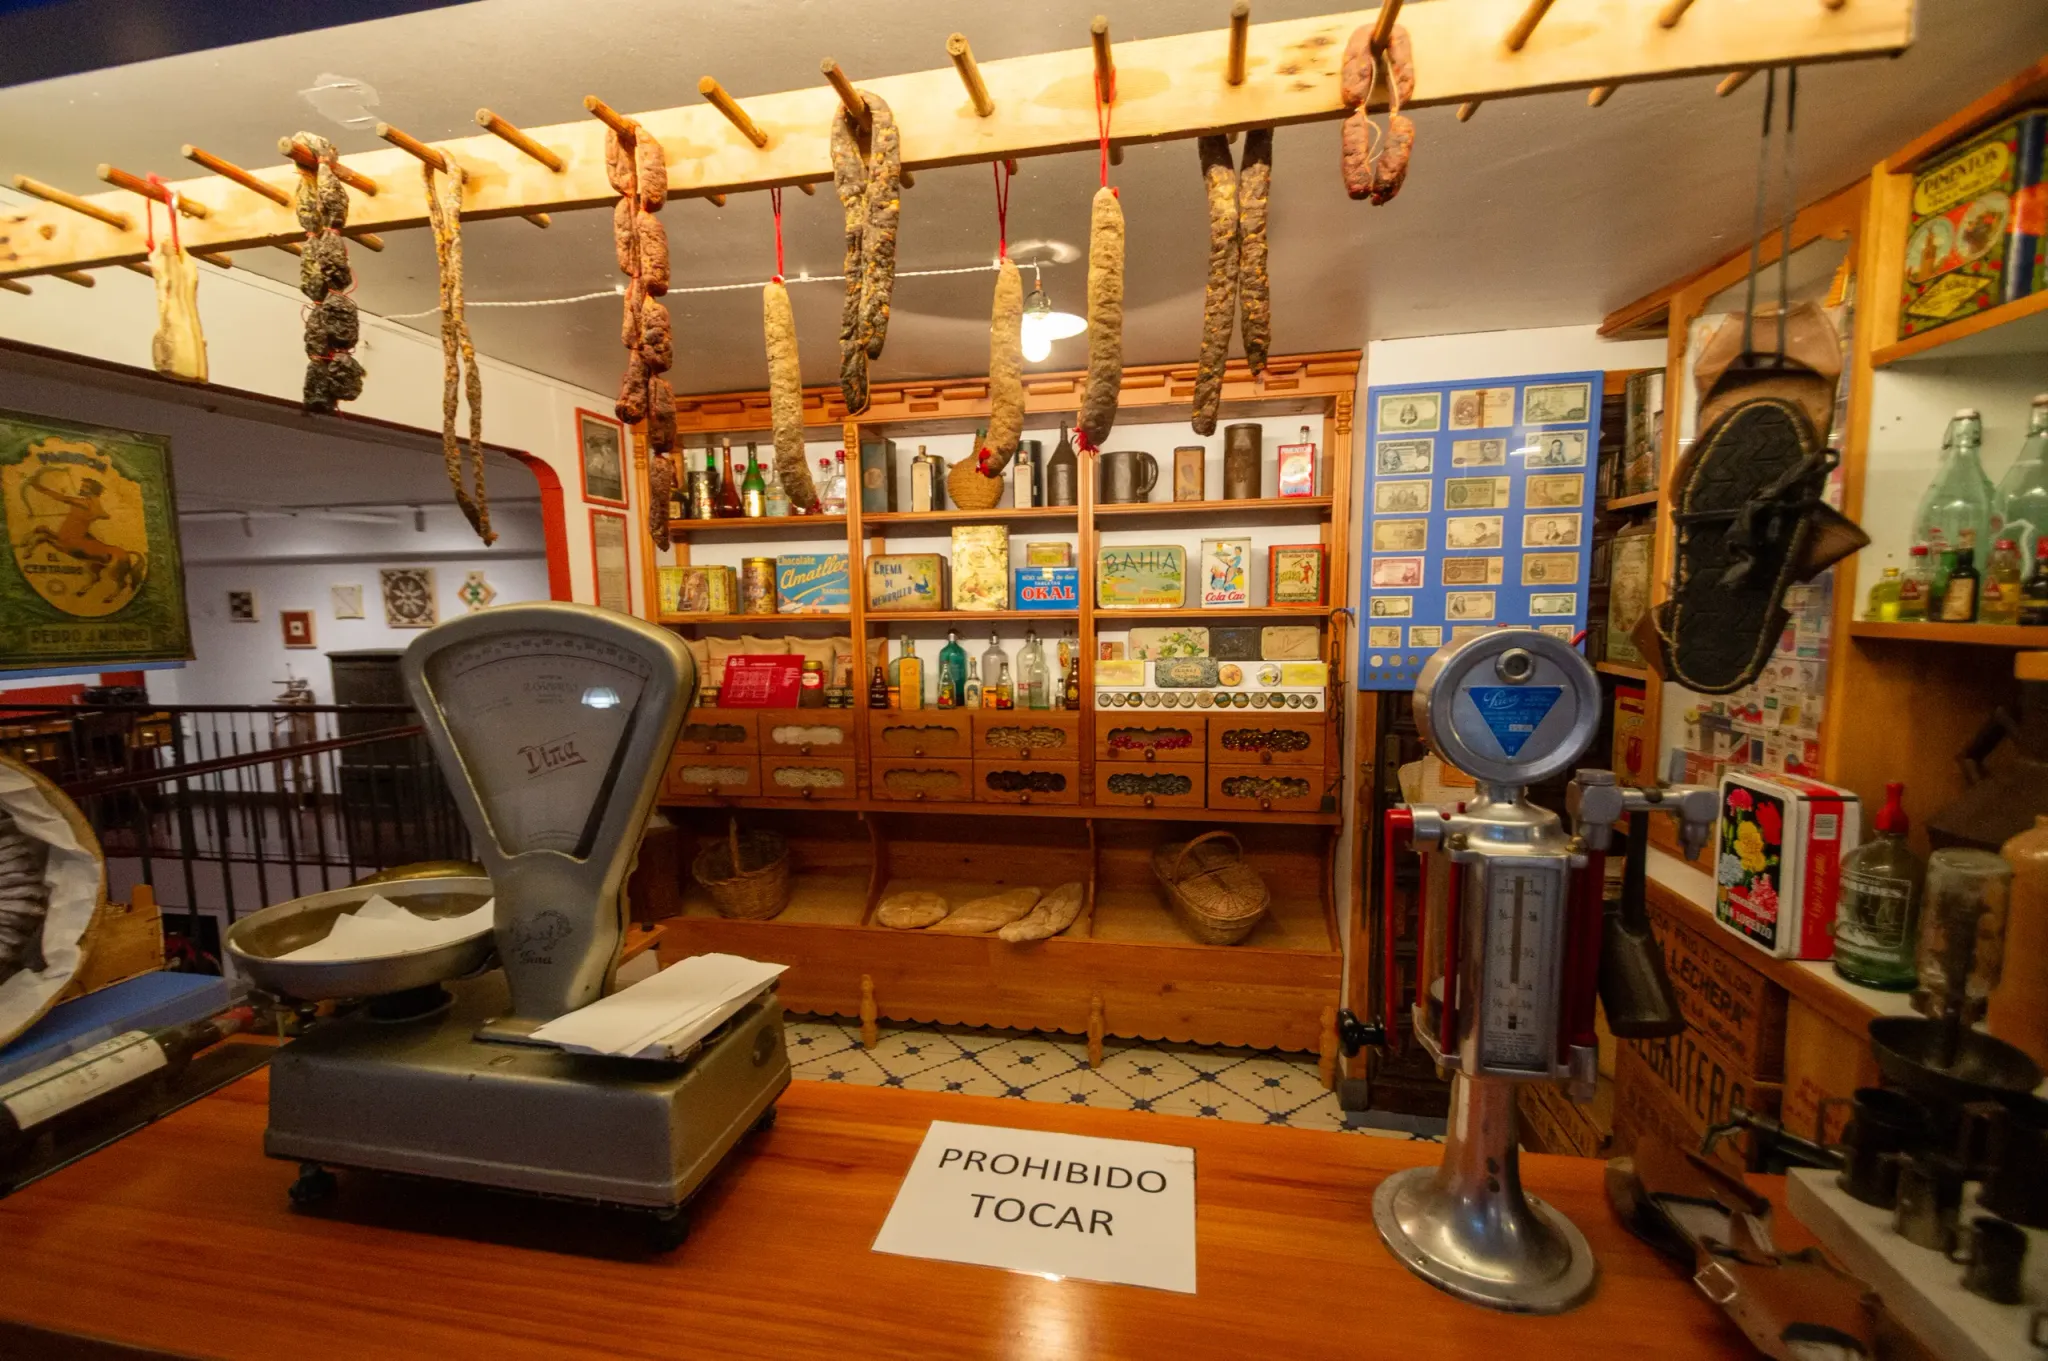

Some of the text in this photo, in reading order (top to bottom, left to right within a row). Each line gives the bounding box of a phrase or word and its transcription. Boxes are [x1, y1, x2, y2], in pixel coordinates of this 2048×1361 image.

[873, 560, 902, 575] CREMA
[1021, 585, 1076, 602] OKAL
[1205, 591, 1246, 601] Cola Cao
[938, 1148, 1167, 1194] PROHIBIDO
[970, 1193, 1114, 1237] TOCAR
